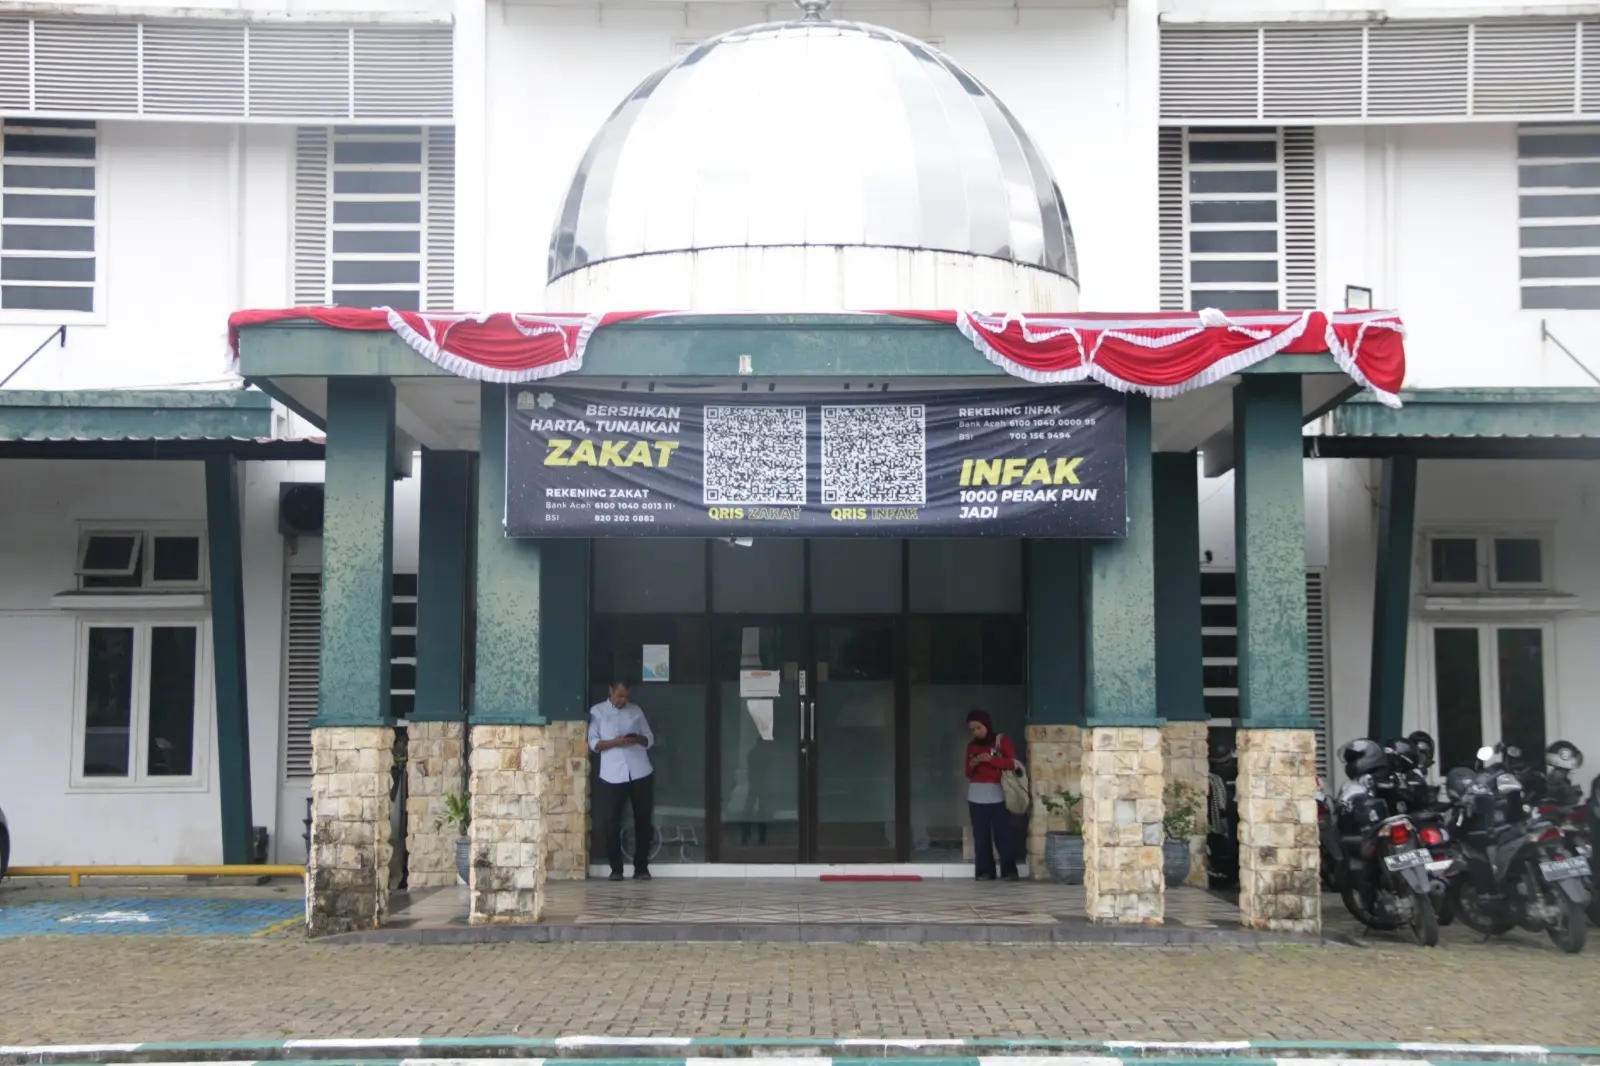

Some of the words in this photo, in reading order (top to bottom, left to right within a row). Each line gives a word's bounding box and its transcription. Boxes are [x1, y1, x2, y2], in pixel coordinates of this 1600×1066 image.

[586, 404, 681, 419] BERSIHKAN
[959, 407, 1022, 417] REKENING
[1024, 405, 1061, 414] INFAK
[530, 419, 591, 434] HARTA,
[596, 420, 680, 433] TUNAIKAN
[1009, 432, 1027, 440] 700
[543, 439, 680, 467] ZAKAT
[959, 458, 1084, 486] INFAK
[546, 488, 607, 498] REKENING
[609, 489, 649, 498] ZAKAT
[959, 490, 997, 503] 1000
[1001, 490, 1058, 502] PERAK
[1061, 488, 1098, 501] PUN
[708, 507, 744, 520] QRIS
[748, 508, 801, 520] ZAKAT
[831, 508, 867, 520] QRIS
[871, 508, 919, 520] INFAK
[959, 507, 999, 519] JADI
